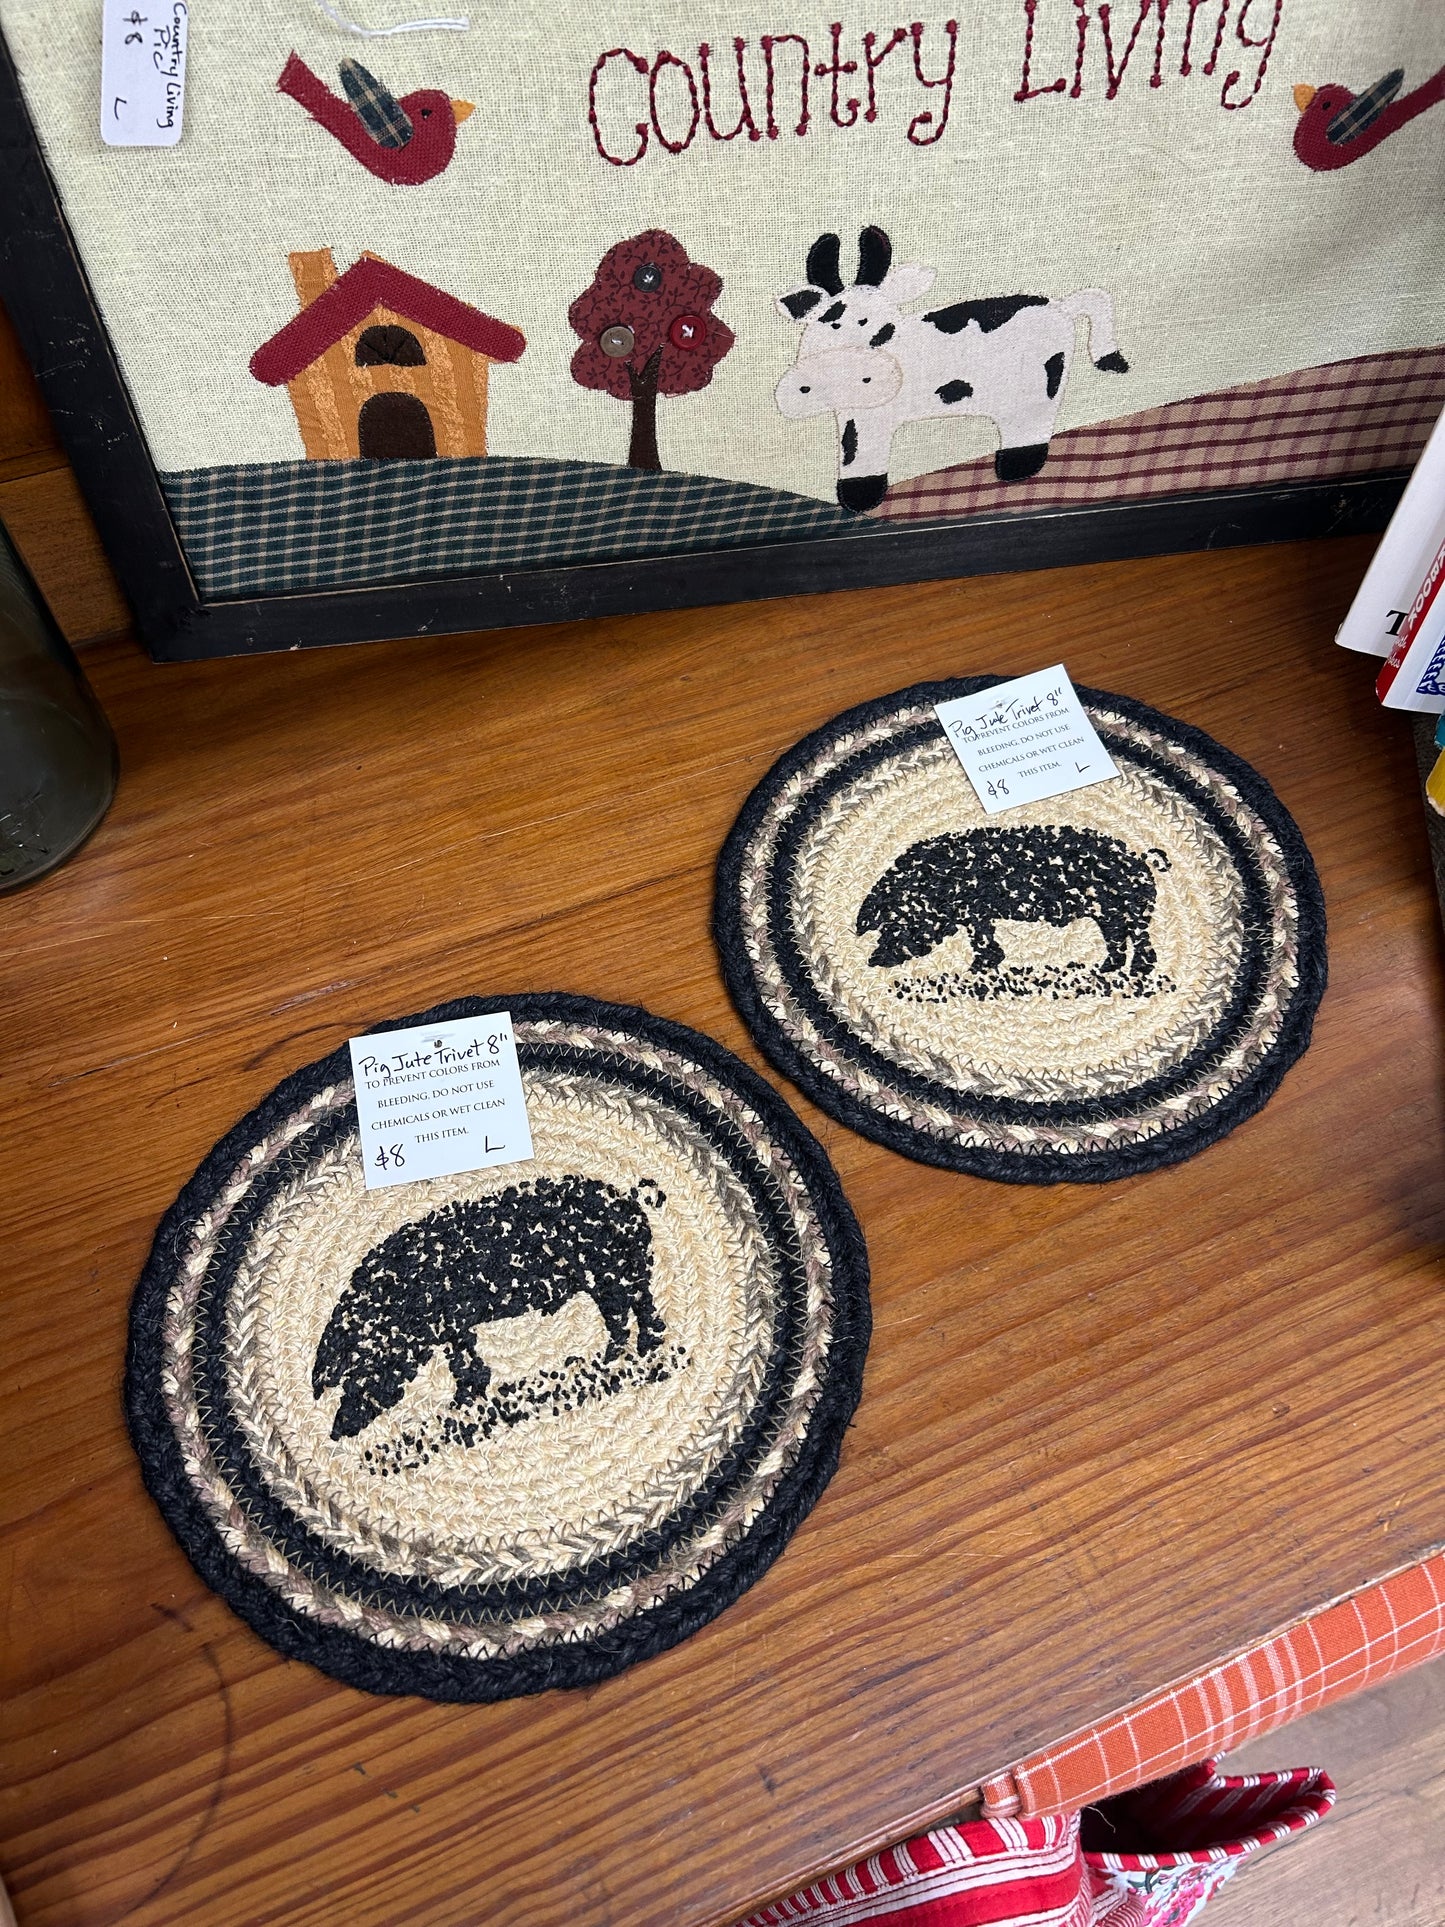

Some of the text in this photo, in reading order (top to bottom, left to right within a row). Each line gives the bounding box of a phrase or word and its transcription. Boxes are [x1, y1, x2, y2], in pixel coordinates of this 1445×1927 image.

[123, 10, 148, 45] $8
[160, 2, 187, 77] Country
[589, 19, 958, 166] Country
[948, 719, 977, 740] Pig
[975, 712, 1008, 730] Jute
[1005, 696, 1043, 720] Trivet
[962, 707, 1070, 744] TO PREVENT COLORS FROM
[1019, 735, 1034, 745] DO
[1034, 730, 1054, 742] NOT
[1054, 724, 1071, 735] USE
[978, 736, 1085, 773] CHEMICALS OR WET CLEAN
[1075, 762, 1091, 773] L
[1017, 766, 1043, 778] THIS
[987, 779, 1010, 799] $8
[358, 1055, 391, 1078] Pig
[391, 1051, 432, 1072] Jute
[434, 1039, 485, 1065] Trivet
[366, 1059, 501, 1090] TO PREVENT COLORS FROM
[432, 1089, 449, 1098] DO
[451, 1083, 474, 1094] NOT
[476, 1080, 495, 1090] USE
[371, 1098, 506, 1131] CHEMICALS OR WET CLEAN
[414, 1127, 469, 1144] THIS ITEM.
[485, 1135, 506, 1153] L
[374, 1143, 405, 1170] $8
